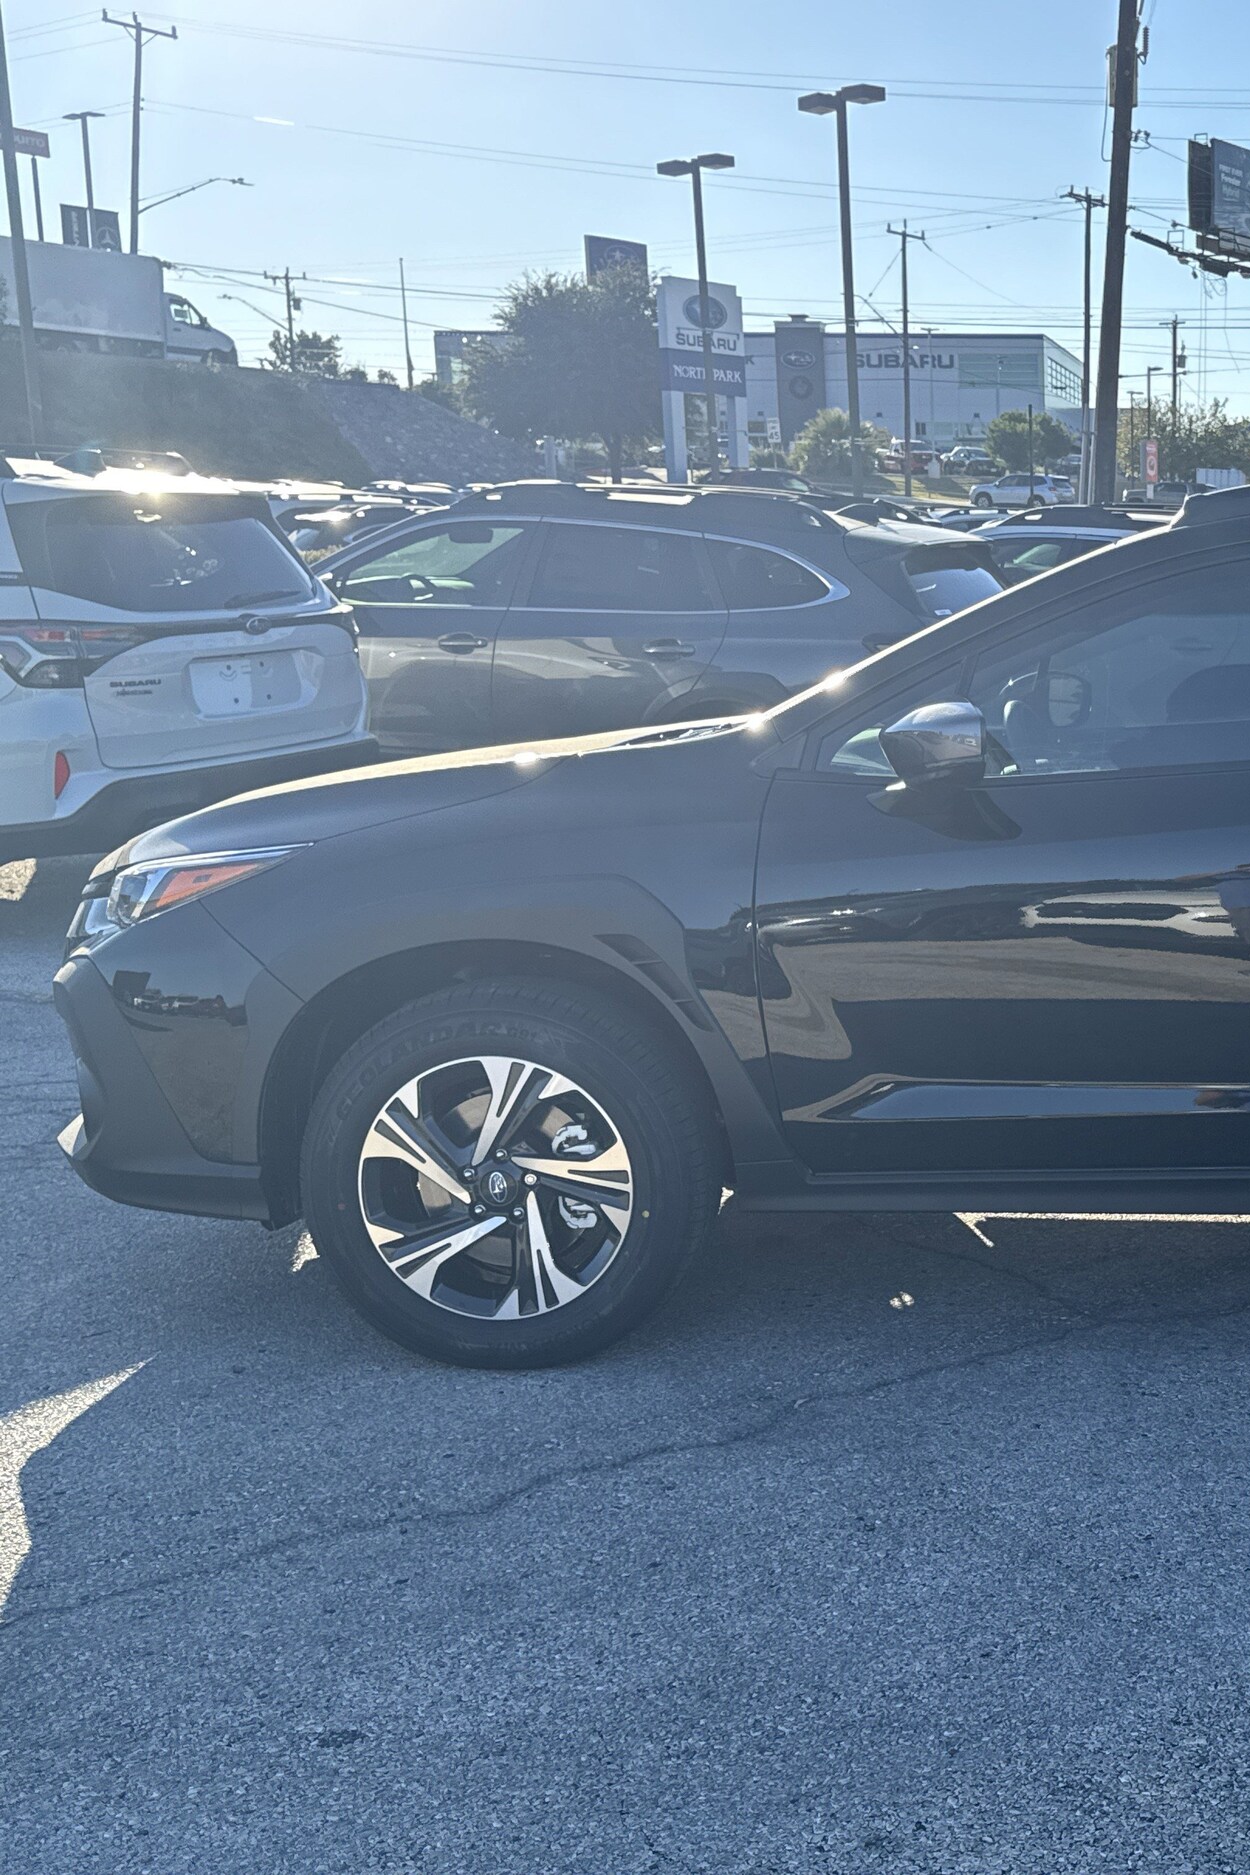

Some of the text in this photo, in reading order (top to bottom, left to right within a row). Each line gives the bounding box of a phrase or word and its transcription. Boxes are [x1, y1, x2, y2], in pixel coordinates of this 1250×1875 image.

[673, 365, 742, 383] NORT PARK
[110, 679, 161, 688] SUBARU
